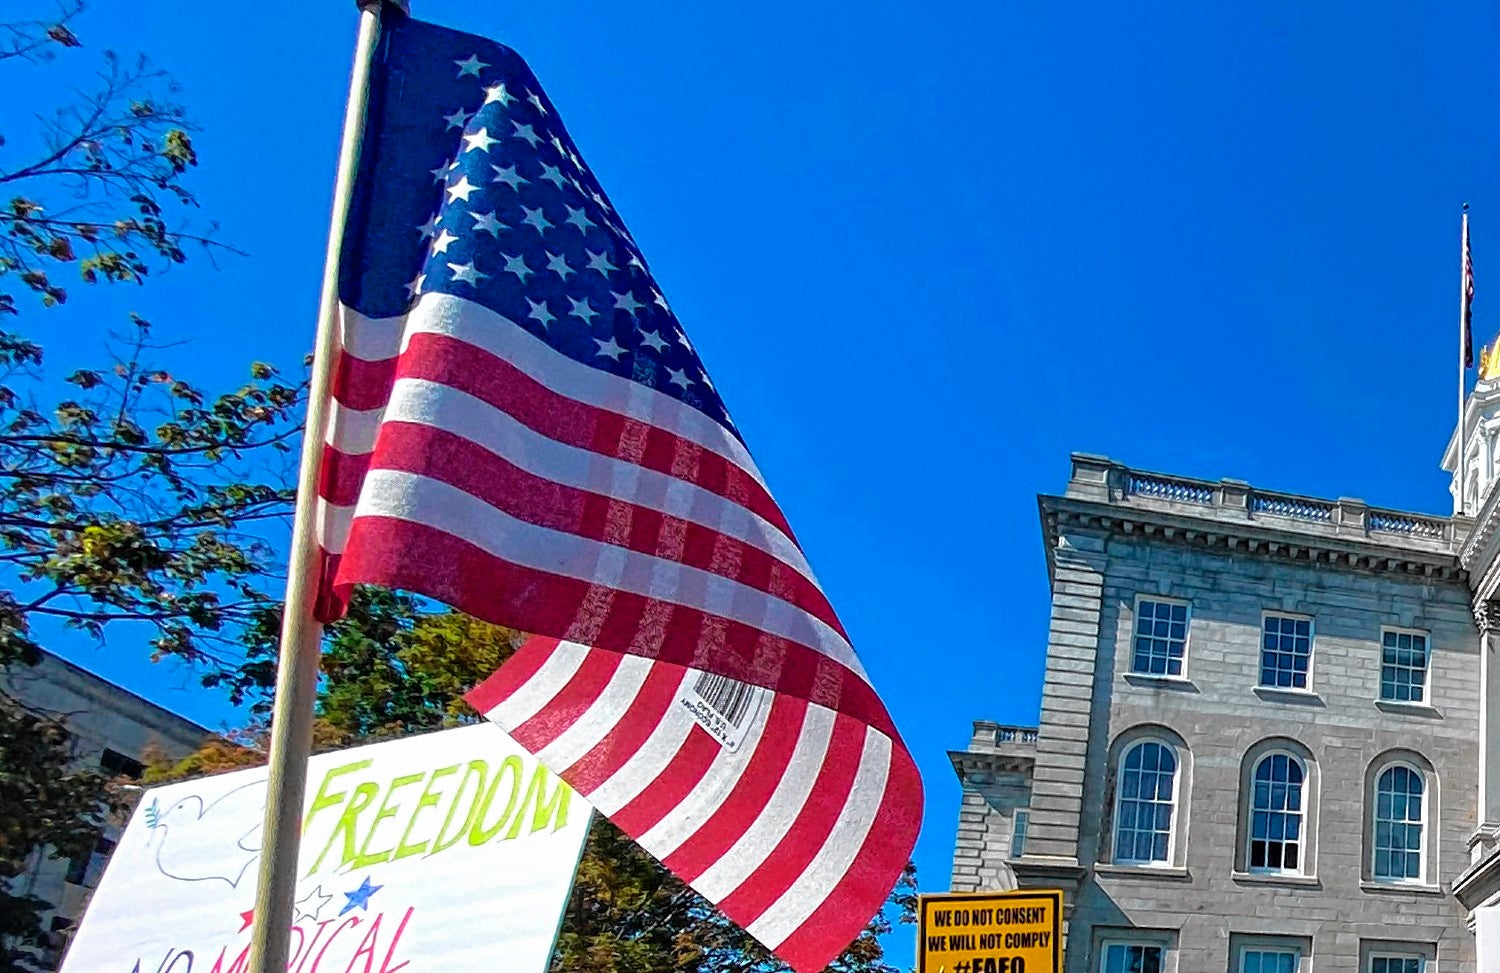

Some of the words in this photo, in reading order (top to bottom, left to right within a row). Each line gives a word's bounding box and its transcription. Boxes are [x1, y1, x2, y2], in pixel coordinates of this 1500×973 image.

[303, 754, 574, 876] FREEDOM
[934, 910, 951, 927] WE
[955, 910, 969, 926] DO
[972, 909, 992, 926] NOT
[996, 907, 1046, 925] CONSENT
[928, 935, 946, 952] WE
[949, 934, 976, 951] WILL
[980, 933, 1002, 950] NOT
[1005, 931, 1051, 949] COMPLY
